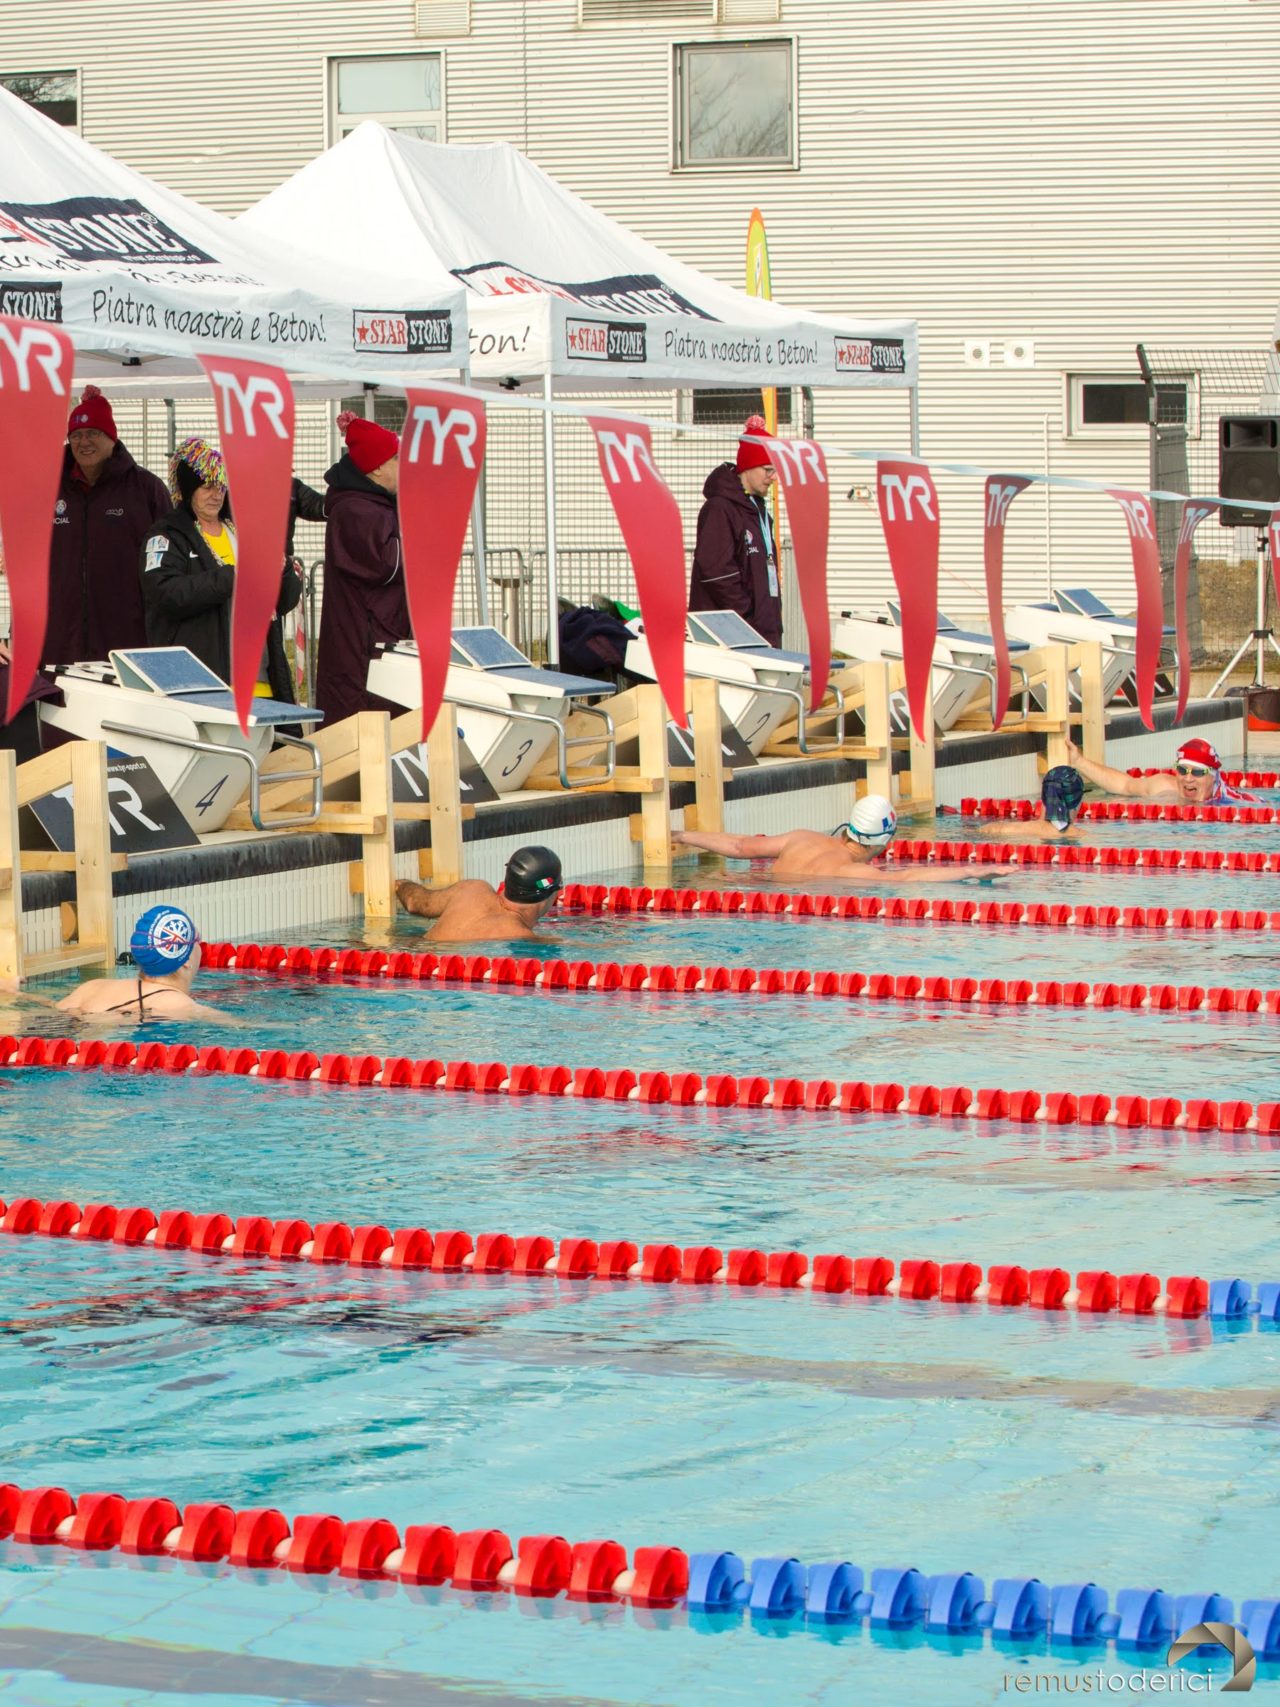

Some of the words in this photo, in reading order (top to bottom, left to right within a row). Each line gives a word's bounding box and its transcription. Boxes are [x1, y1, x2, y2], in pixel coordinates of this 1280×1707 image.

[93, 286, 157, 329] Piatra
[164, 309, 244, 340] noastră
[250, 316, 261, 341] e
[268, 311, 327, 343] Beton!
[370, 319, 407, 345] STAR
[577, 328, 605, 352] STAR
[665, 328, 707, 360] Piatra
[711, 339, 762, 365] noastră
[766, 346, 774, 365] e
[777, 338, 819, 365] Beton!
[846, 344, 871, 365] STAR
[211, 370, 290, 439] TYR
[408, 405, 477, 469] TYR
[766, 440, 826, 487] TYR
[881, 474, 937, 521] TYR
[1117, 498, 1154, 540] TYR
[943, 689, 966, 719] 1
[745, 712, 771, 745] 2
[501, 739, 534, 777] 3
[194, 774, 230, 817] 4
